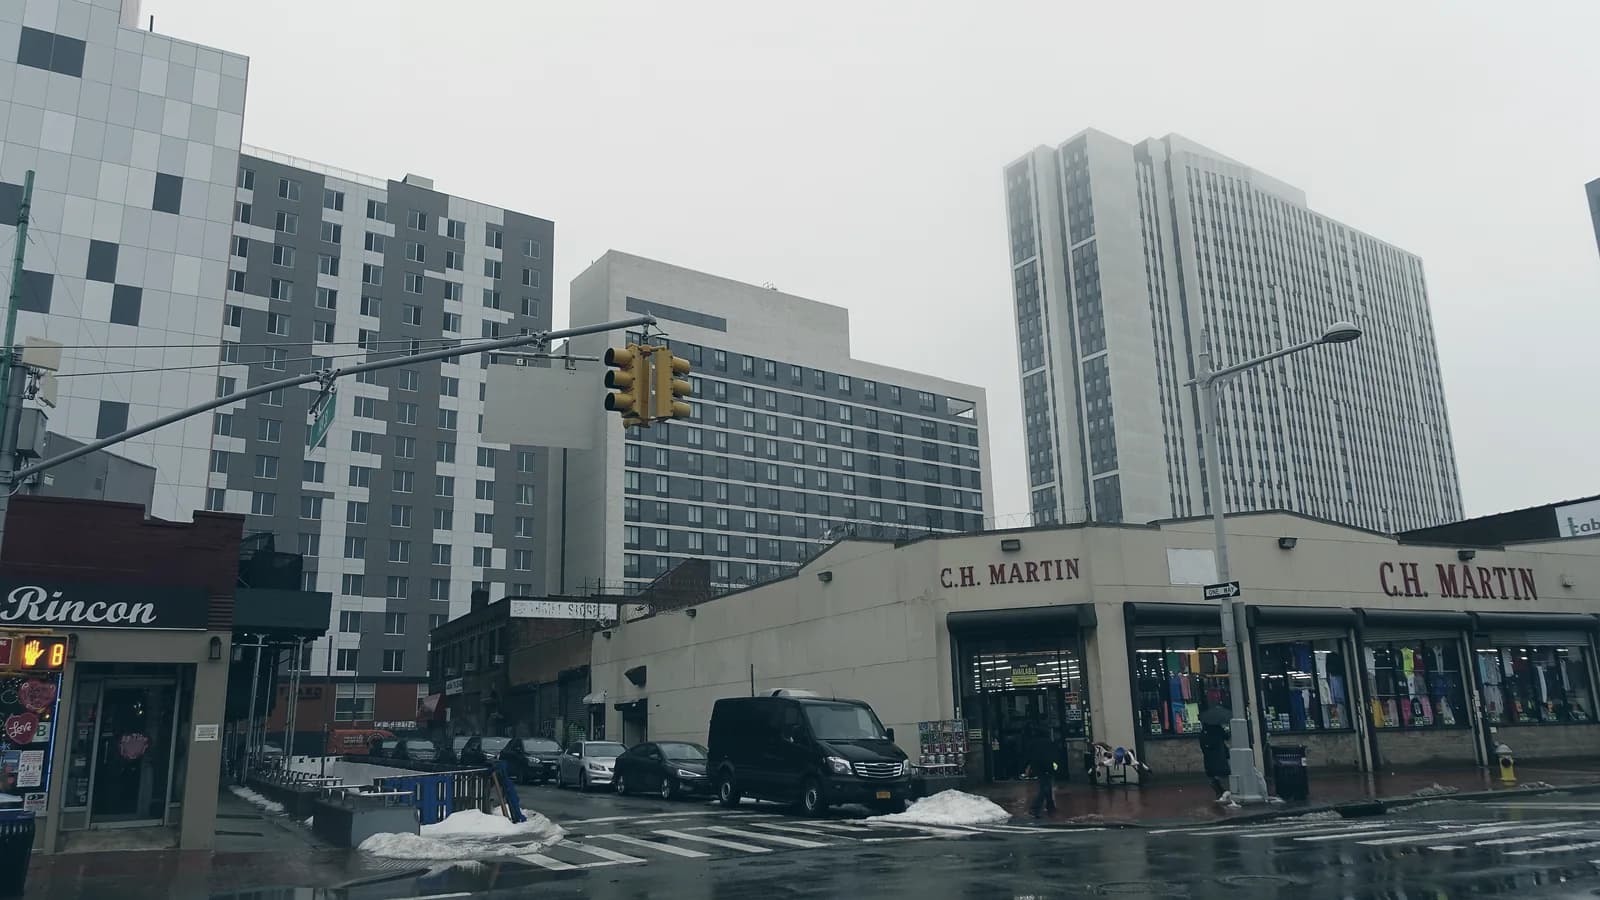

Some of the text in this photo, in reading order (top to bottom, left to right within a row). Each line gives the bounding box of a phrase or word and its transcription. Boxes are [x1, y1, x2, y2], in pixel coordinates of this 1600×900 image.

[940, 558, 1080, 588] C.H. MARTIN
[1379, 561, 1538, 600] C.H. MARTIN
[0, 585, 157, 624] Rincon
[52, 643, 64, 667] 8
[9, 721, 33, 738] Love
